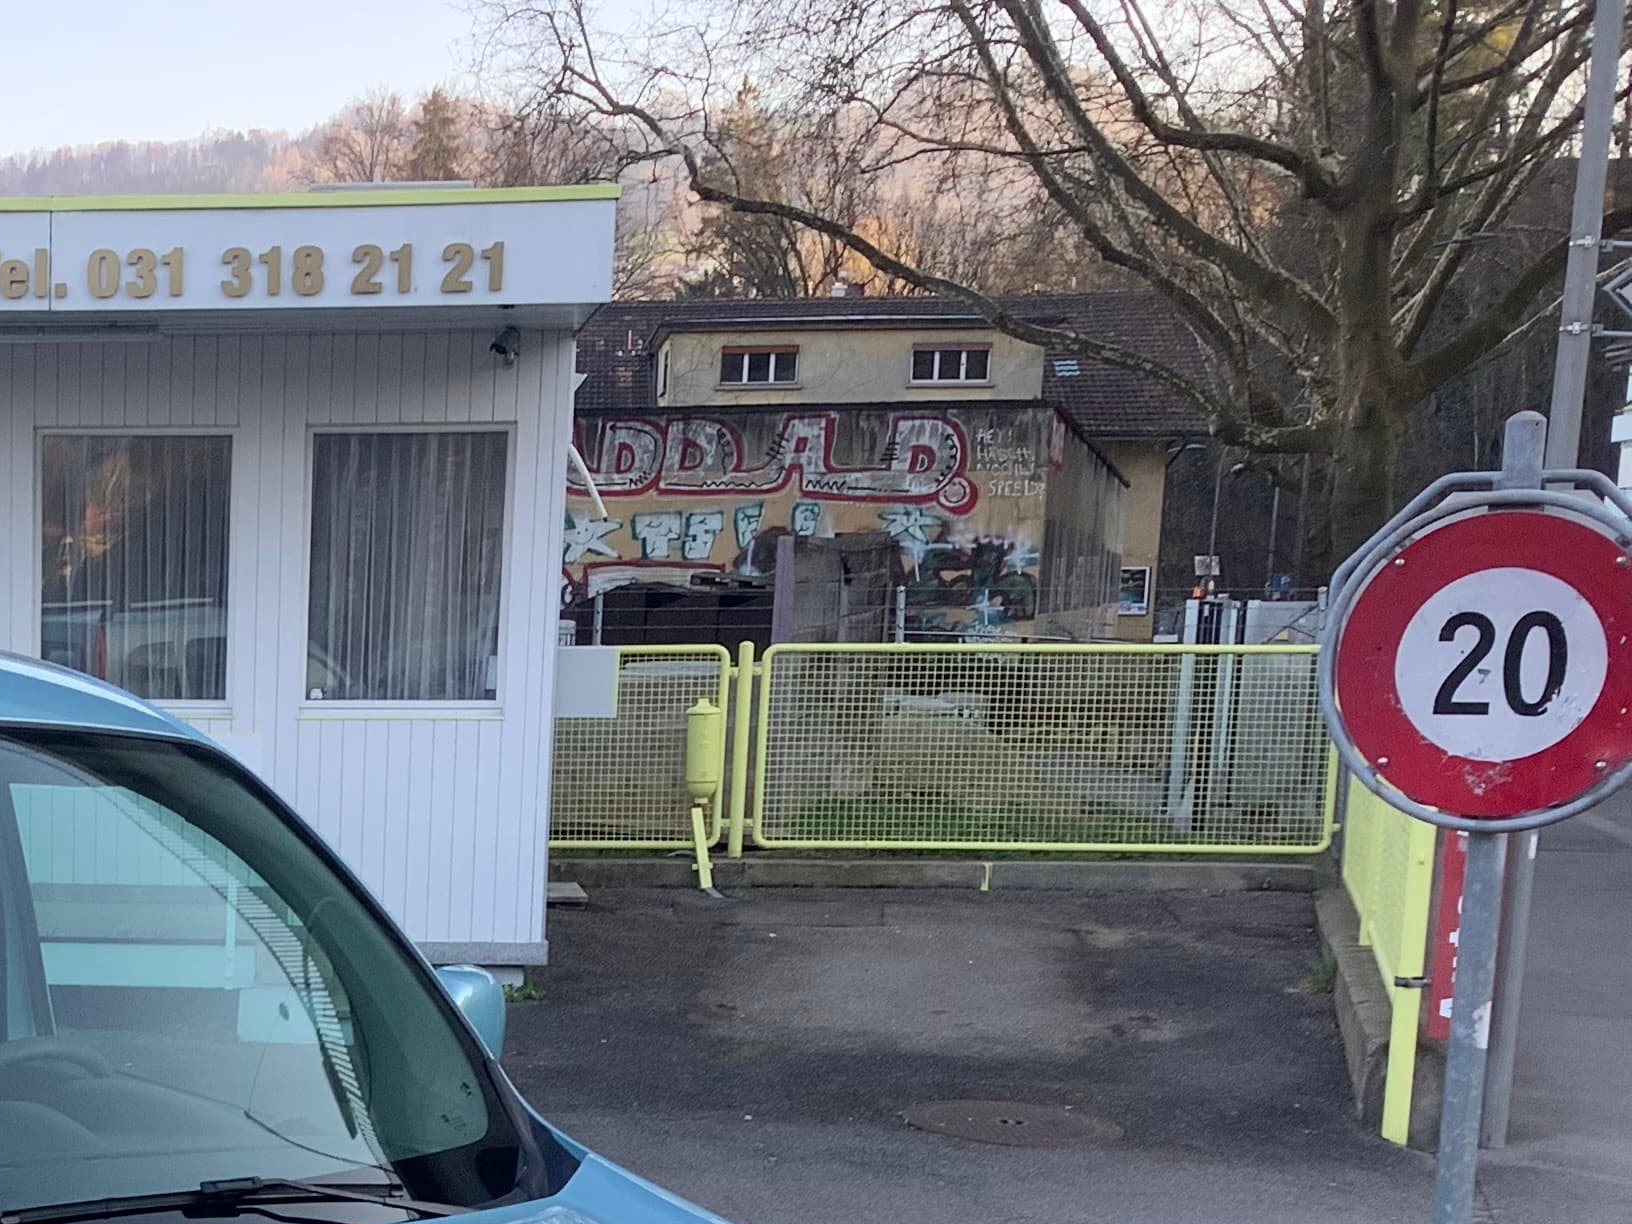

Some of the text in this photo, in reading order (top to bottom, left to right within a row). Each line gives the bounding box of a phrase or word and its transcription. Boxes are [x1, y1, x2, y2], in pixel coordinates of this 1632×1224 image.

[87, 246, 185, 298] 031
[221, 244, 325, 298] 318
[350, 242, 412, 295] 21
[440, 240, 506, 293] 21
[1432, 609, 1568, 718] 20
